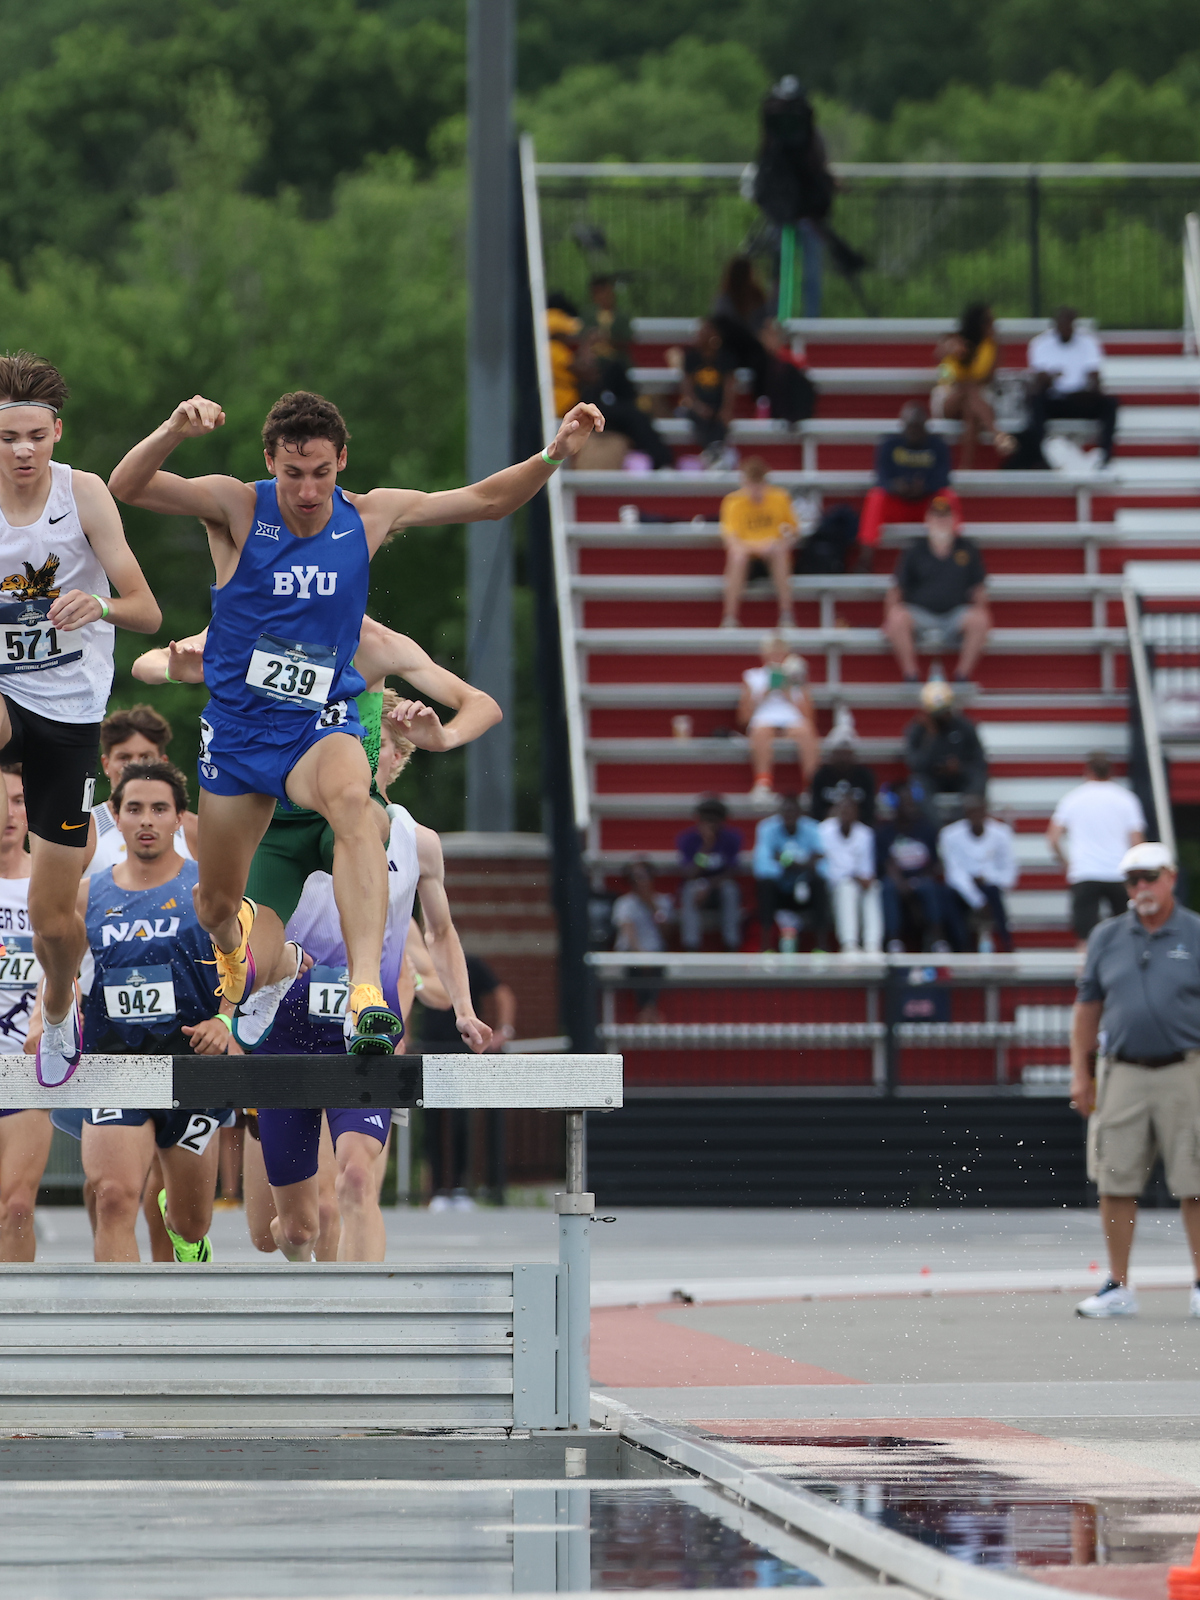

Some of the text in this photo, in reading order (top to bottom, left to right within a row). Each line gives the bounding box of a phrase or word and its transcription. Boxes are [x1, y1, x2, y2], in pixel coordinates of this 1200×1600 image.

[273, 566, 337, 599] BYU
[5, 627, 61, 660] 571
[263, 661, 316, 695] 239
[101, 917, 180, 947] NAU
[118, 989, 162, 1015] 942
[182, 1117, 211, 1150] 2
